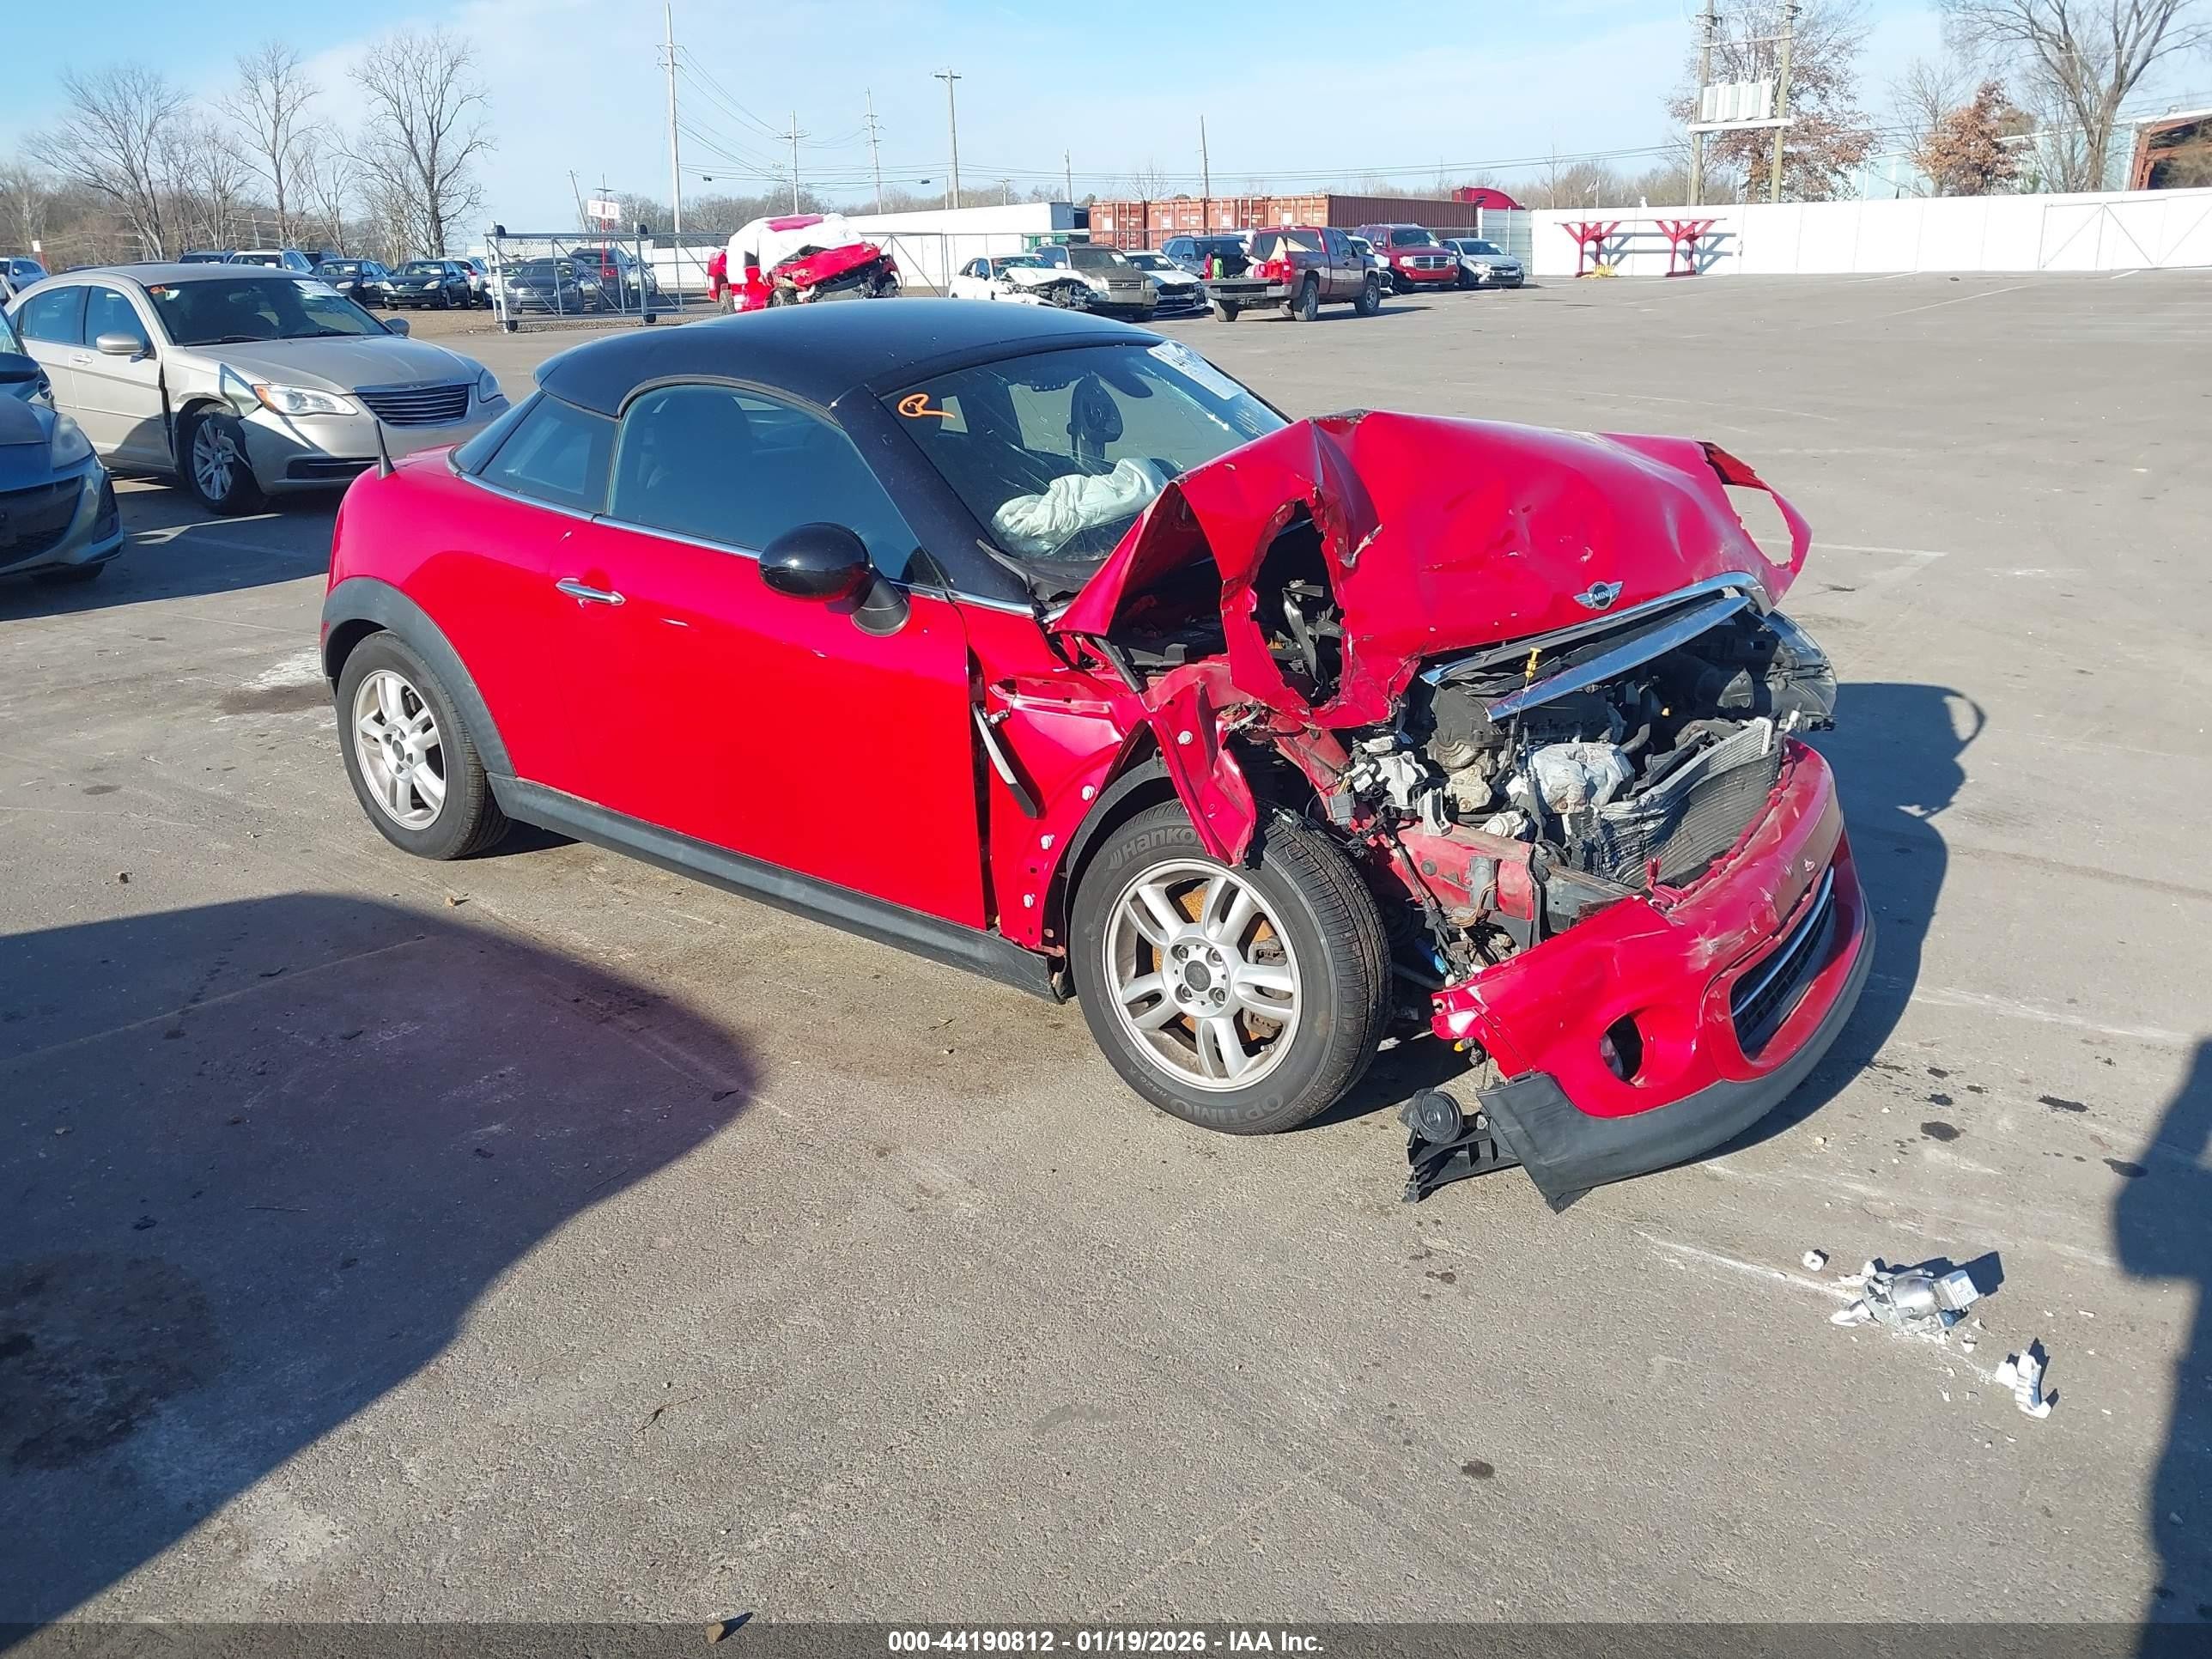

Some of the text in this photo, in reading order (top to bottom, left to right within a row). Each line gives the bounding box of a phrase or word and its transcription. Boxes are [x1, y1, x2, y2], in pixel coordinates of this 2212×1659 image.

[1594, 590, 1610, 601] MINI
[1121, 828, 1200, 859] Hanko
[1170, 1093, 1284, 1121] OPTIMO
